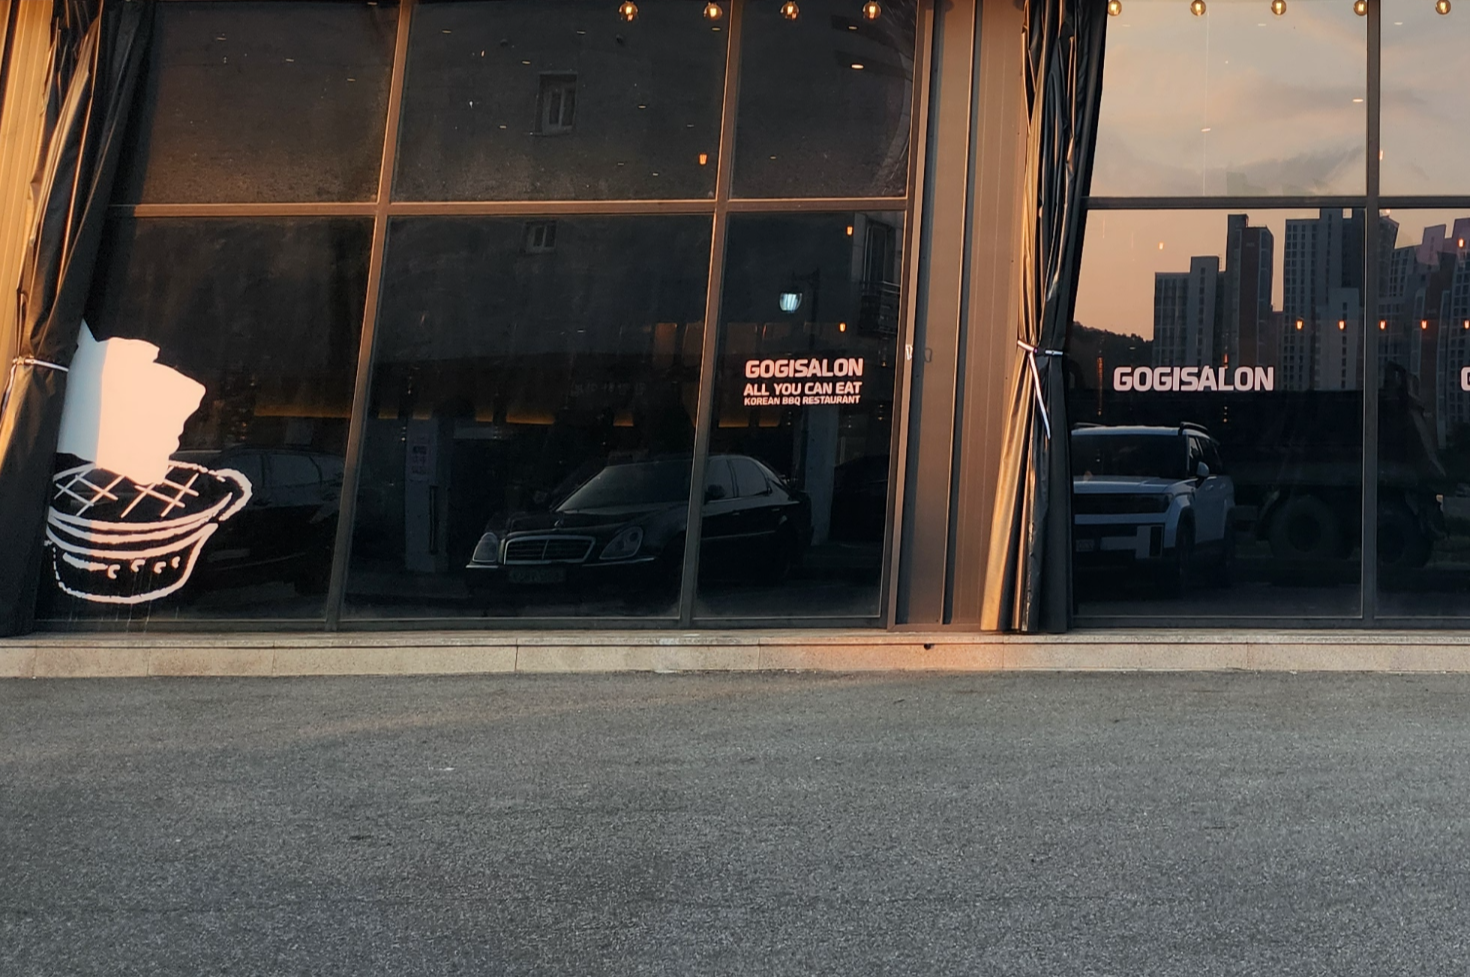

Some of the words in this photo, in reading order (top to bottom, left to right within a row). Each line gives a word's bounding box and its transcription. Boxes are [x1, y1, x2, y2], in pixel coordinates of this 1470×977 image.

[745, 358, 864, 379] GOGISALON
[1113, 365, 1275, 393] GOGISALON
[743, 383, 770, 397] ALL
[774, 382, 801, 396] YOU
[804, 382, 832, 395] CAN
[835, 381, 862, 394] EAT
[744, 396, 780, 406] KOREAN
[782, 396, 800, 406] BBQ
[802, 395, 861, 405] RESTAURANT
